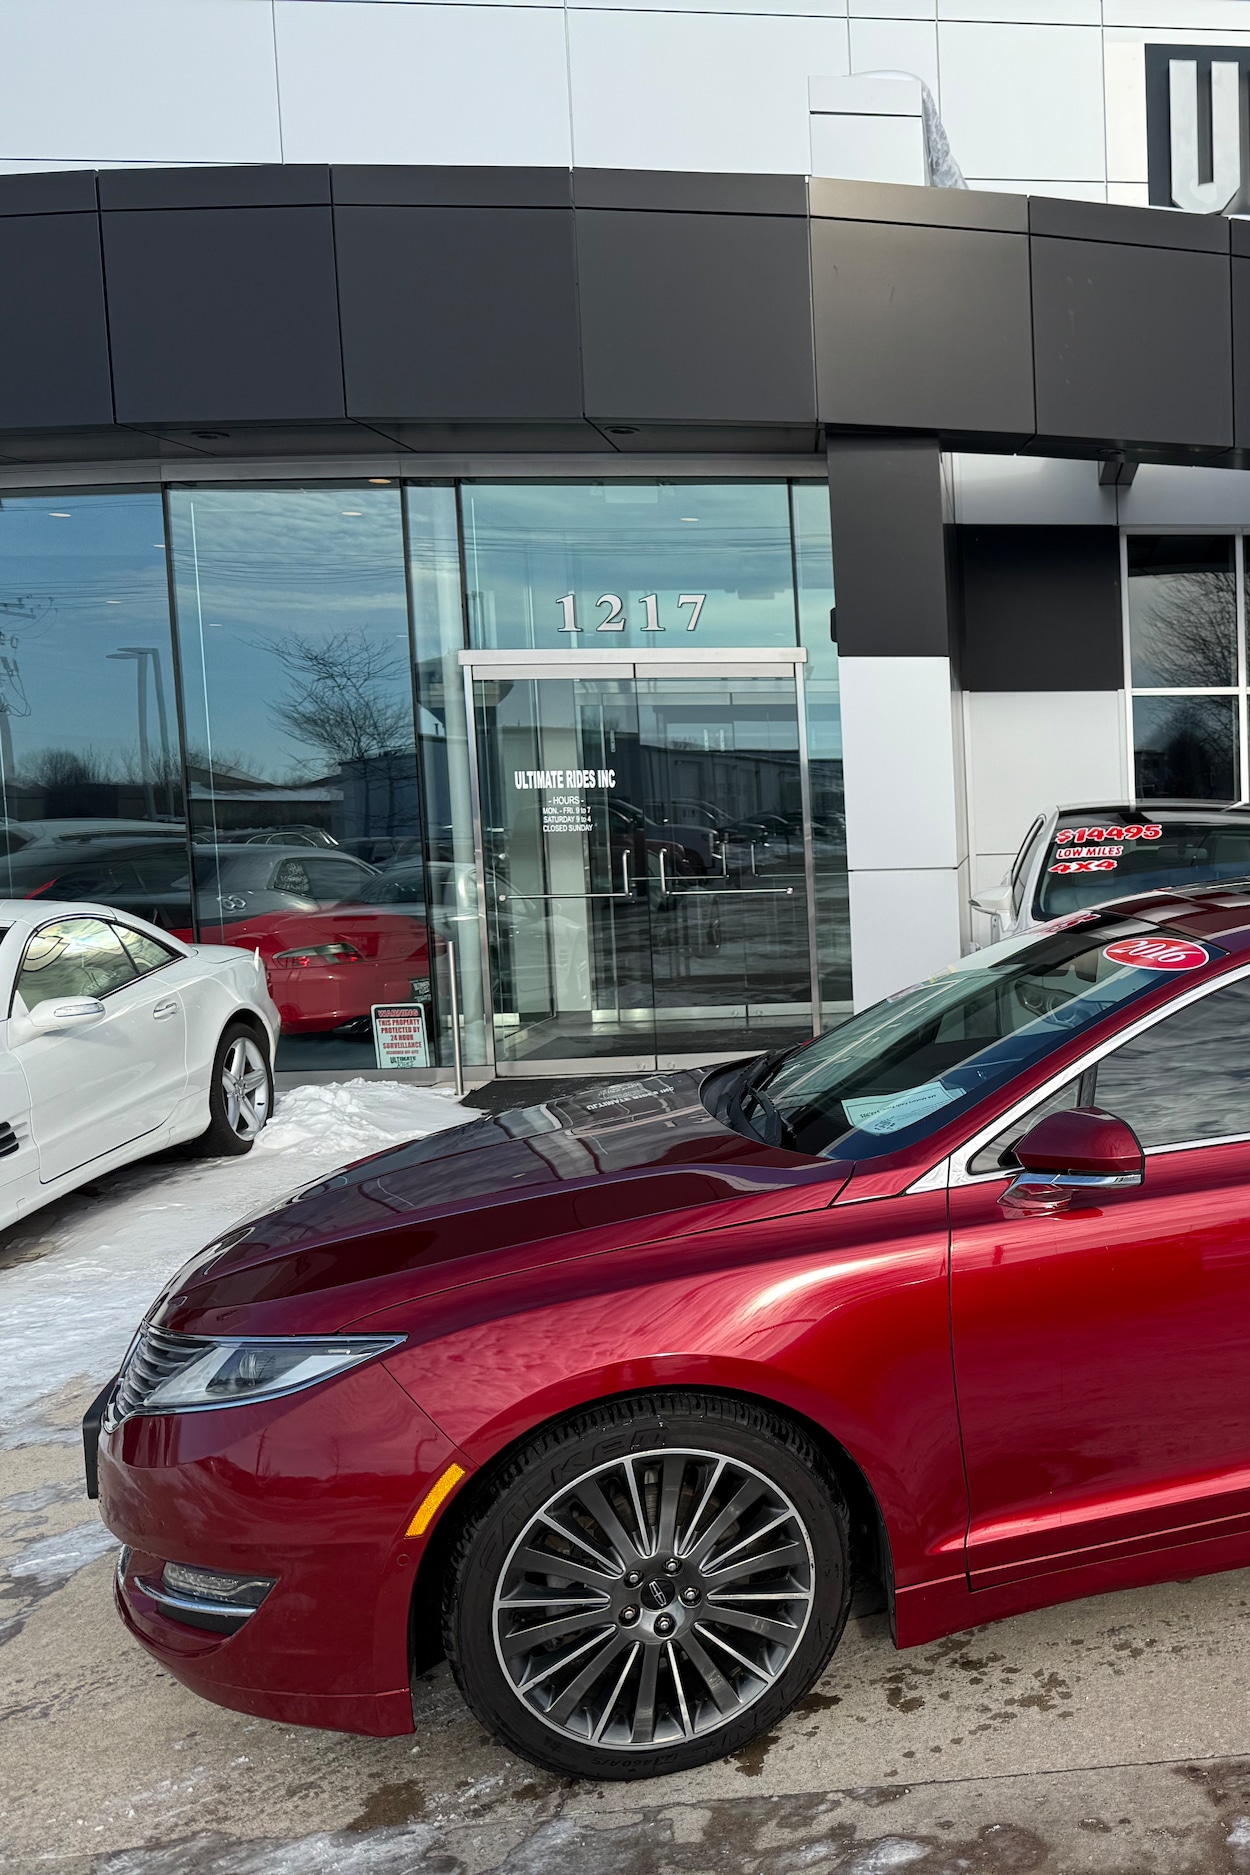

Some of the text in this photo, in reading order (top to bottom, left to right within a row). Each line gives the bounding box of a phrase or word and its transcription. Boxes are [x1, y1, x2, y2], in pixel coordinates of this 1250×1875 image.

[556, 593, 706, 632] 1217
[514, 769, 616, 789] ULTIMATE RIDES INC
[553, 796, 580, 804] HOURS
[1056, 824, 1163, 843] $14495
[1056, 846, 1123, 859] LOW MILES
[1107, 940, 1202, 963] 2016
[378, 1009, 418, 1018] WARNING
